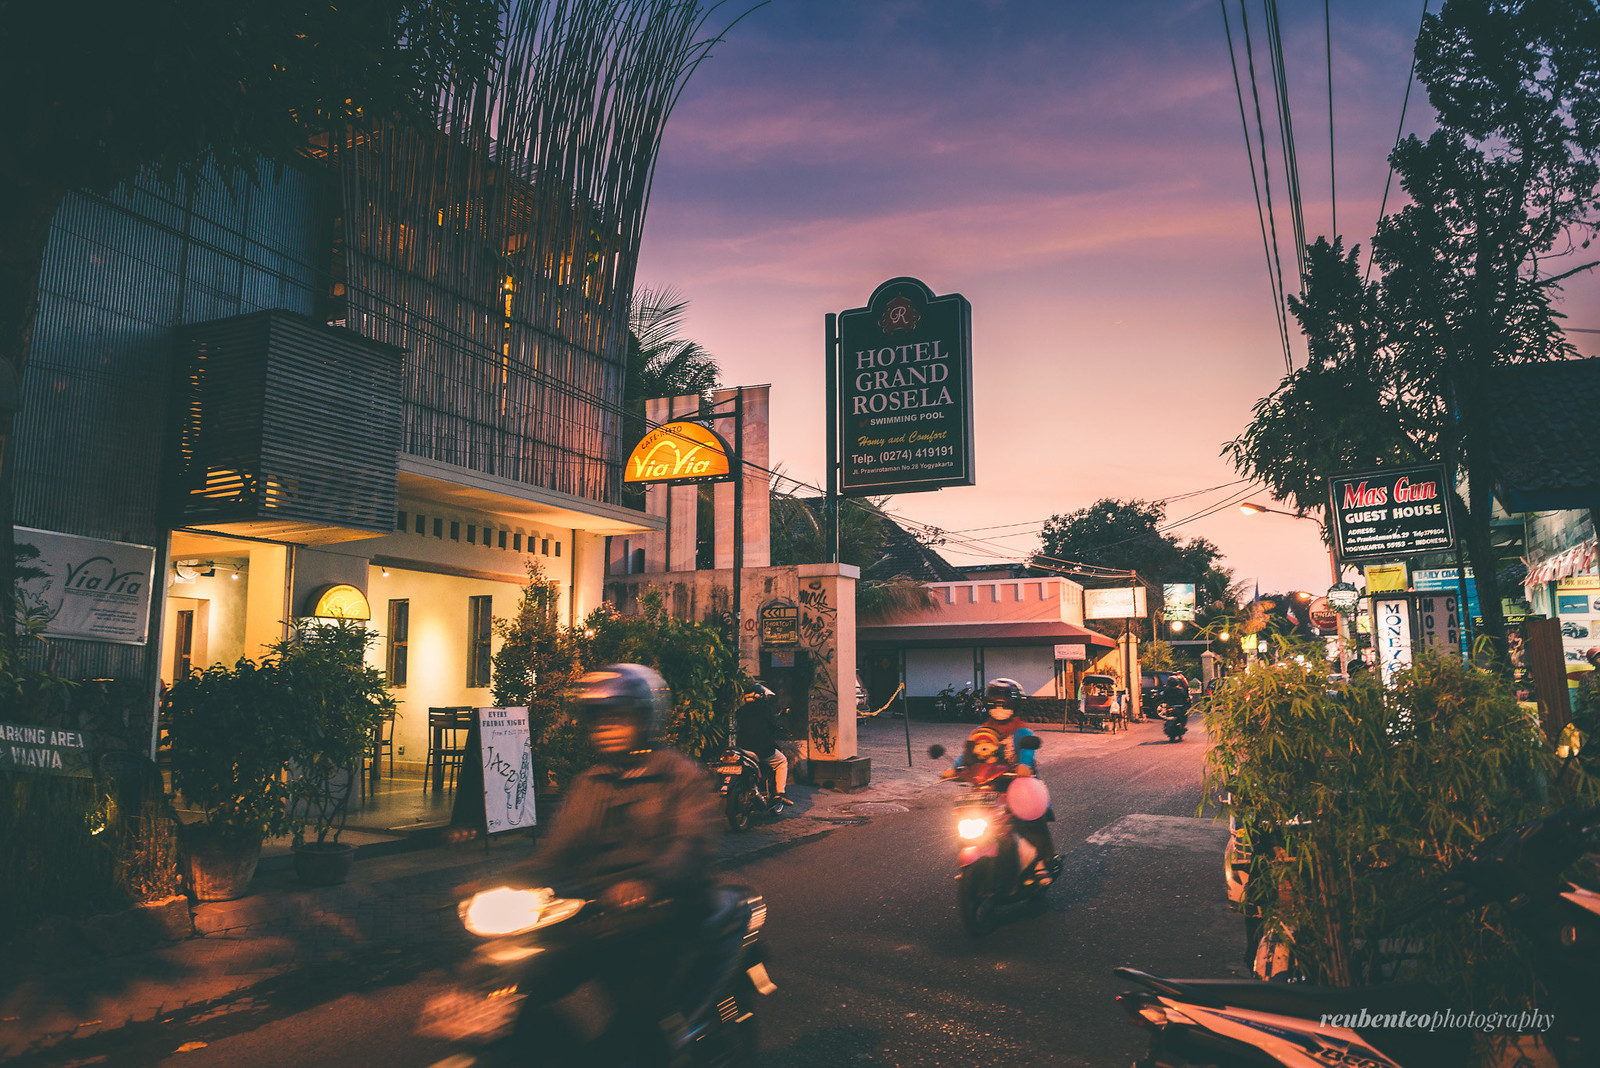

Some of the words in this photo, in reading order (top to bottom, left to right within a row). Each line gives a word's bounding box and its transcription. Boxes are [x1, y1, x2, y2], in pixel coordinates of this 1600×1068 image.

[855, 340, 949, 370] HOTEL
[855, 363, 949, 392] GRAND
[852, 385, 955, 416] ROSELA
[870, 414, 918, 426] SWIMMING
[919, 412, 945, 421] POOL
[857, 435, 886, 447] Homy
[887, 433, 906, 444] and
[908, 429, 948, 444] Comfort
[851, 453, 877, 465] Telp.
[879, 449, 912, 464] (0274)
[915, 445, 953, 458] 419191
[860, 465, 901, 475] Prawirotaman
[920, 461, 954, 470] Yogyakarta
[1341, 480, 1388, 510] Mas
[1393, 475, 1438, 504] Gun
[1344, 509, 1388, 524] GUEST
[1392, 503, 1442, 520] HOUSE
[1345, 543, 1386, 553] YOGYAKARTA
[1385, 604, 1402, 660] MONEY
[0, 725, 46, 744] ARKING
[50, 731, 84, 748] AREA
[11, 746, 63, 769] VIAVIA
